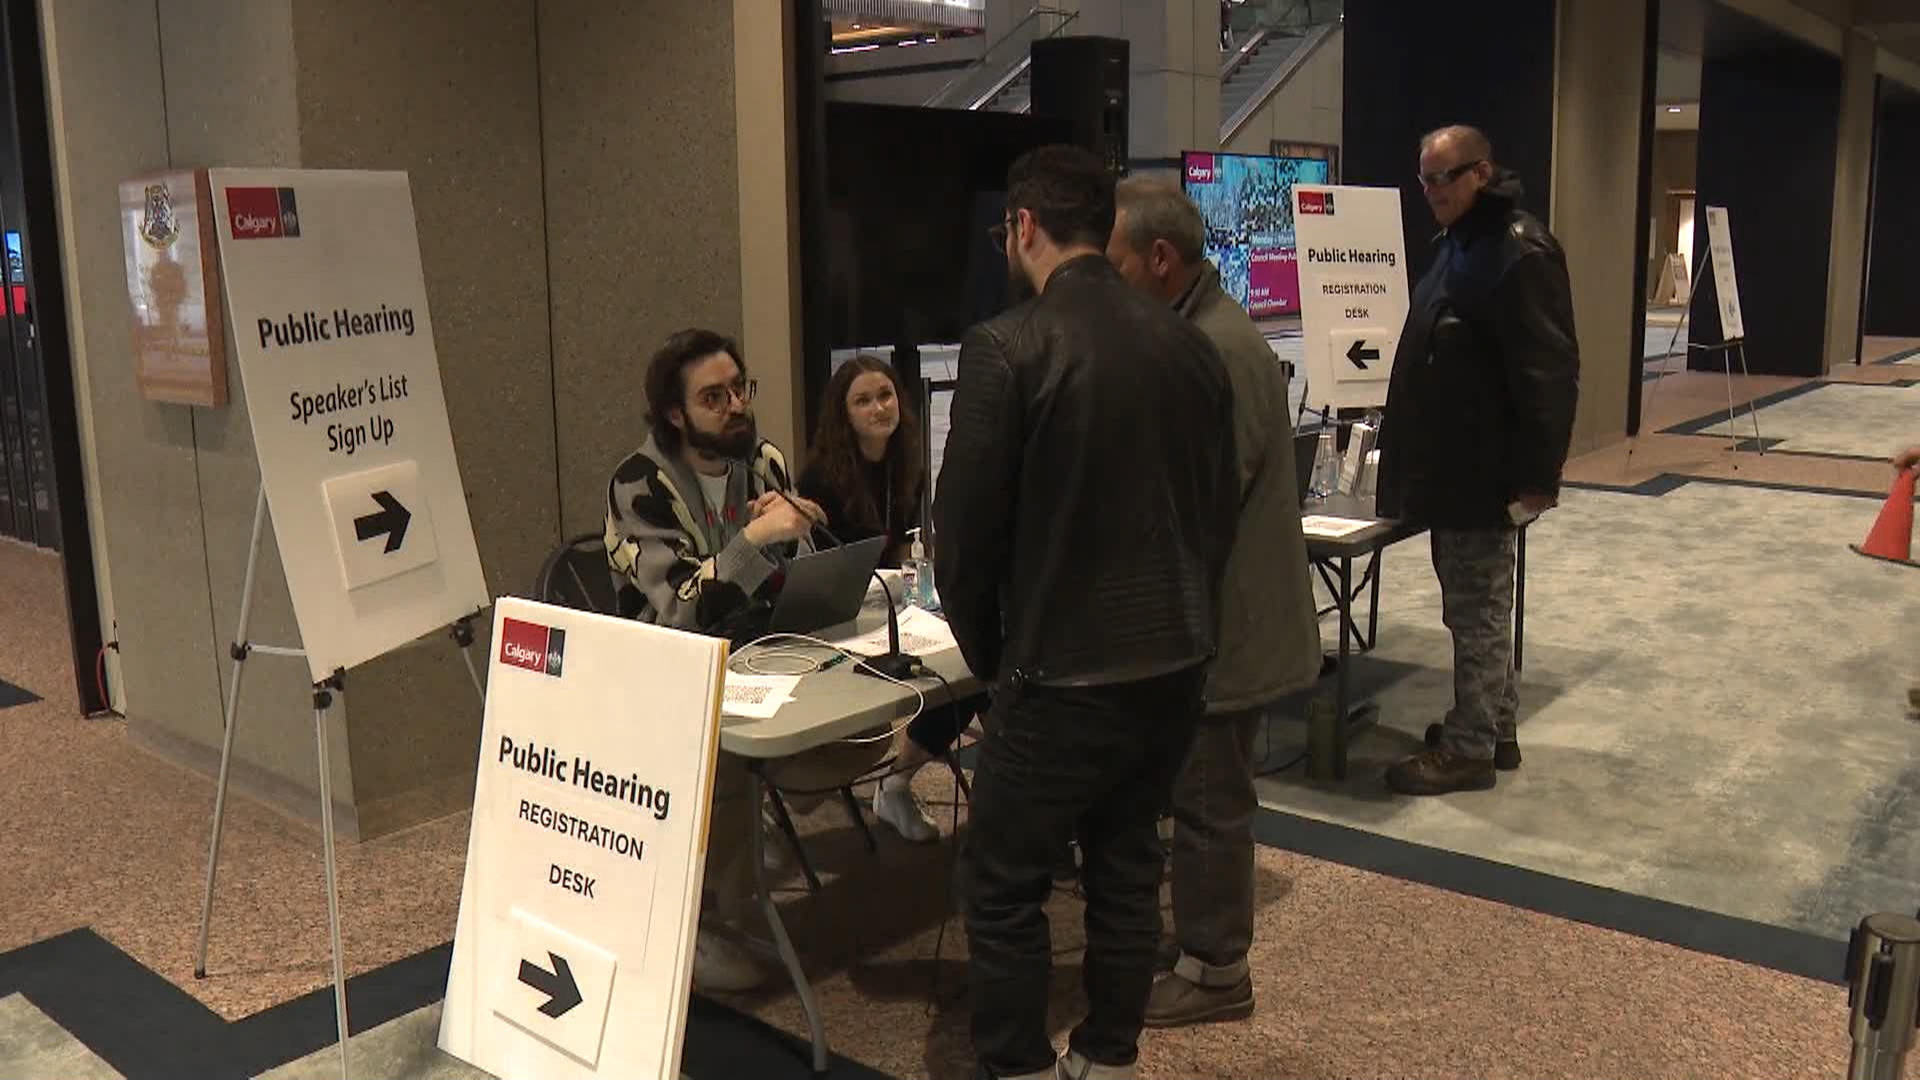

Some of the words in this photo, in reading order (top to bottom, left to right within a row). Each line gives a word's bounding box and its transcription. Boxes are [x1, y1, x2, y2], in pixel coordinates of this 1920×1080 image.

[1188, 166, 1211, 180] Calgary
[1301, 202, 1323, 212] Calgary
[234, 213, 277, 233] Calgary
[1308, 248, 1346, 262] Public
[1348, 248, 1396, 266] Hearing
[1322, 283, 1386, 295] REGISTRATION
[1344, 308, 1369, 318] DESK
[257, 311, 331, 349] Public
[333, 304, 416, 339] Hearing
[379, 374, 409, 401] List
[327, 423, 366, 455] Sign
[370, 415, 394, 445] Up
[504, 642, 542, 667] Calgary
[499, 735, 568, 782] Public
[572, 757, 671, 820] Hearing
[519, 799, 644, 861] REGISTRATION
[549, 863, 596, 899] DESK
